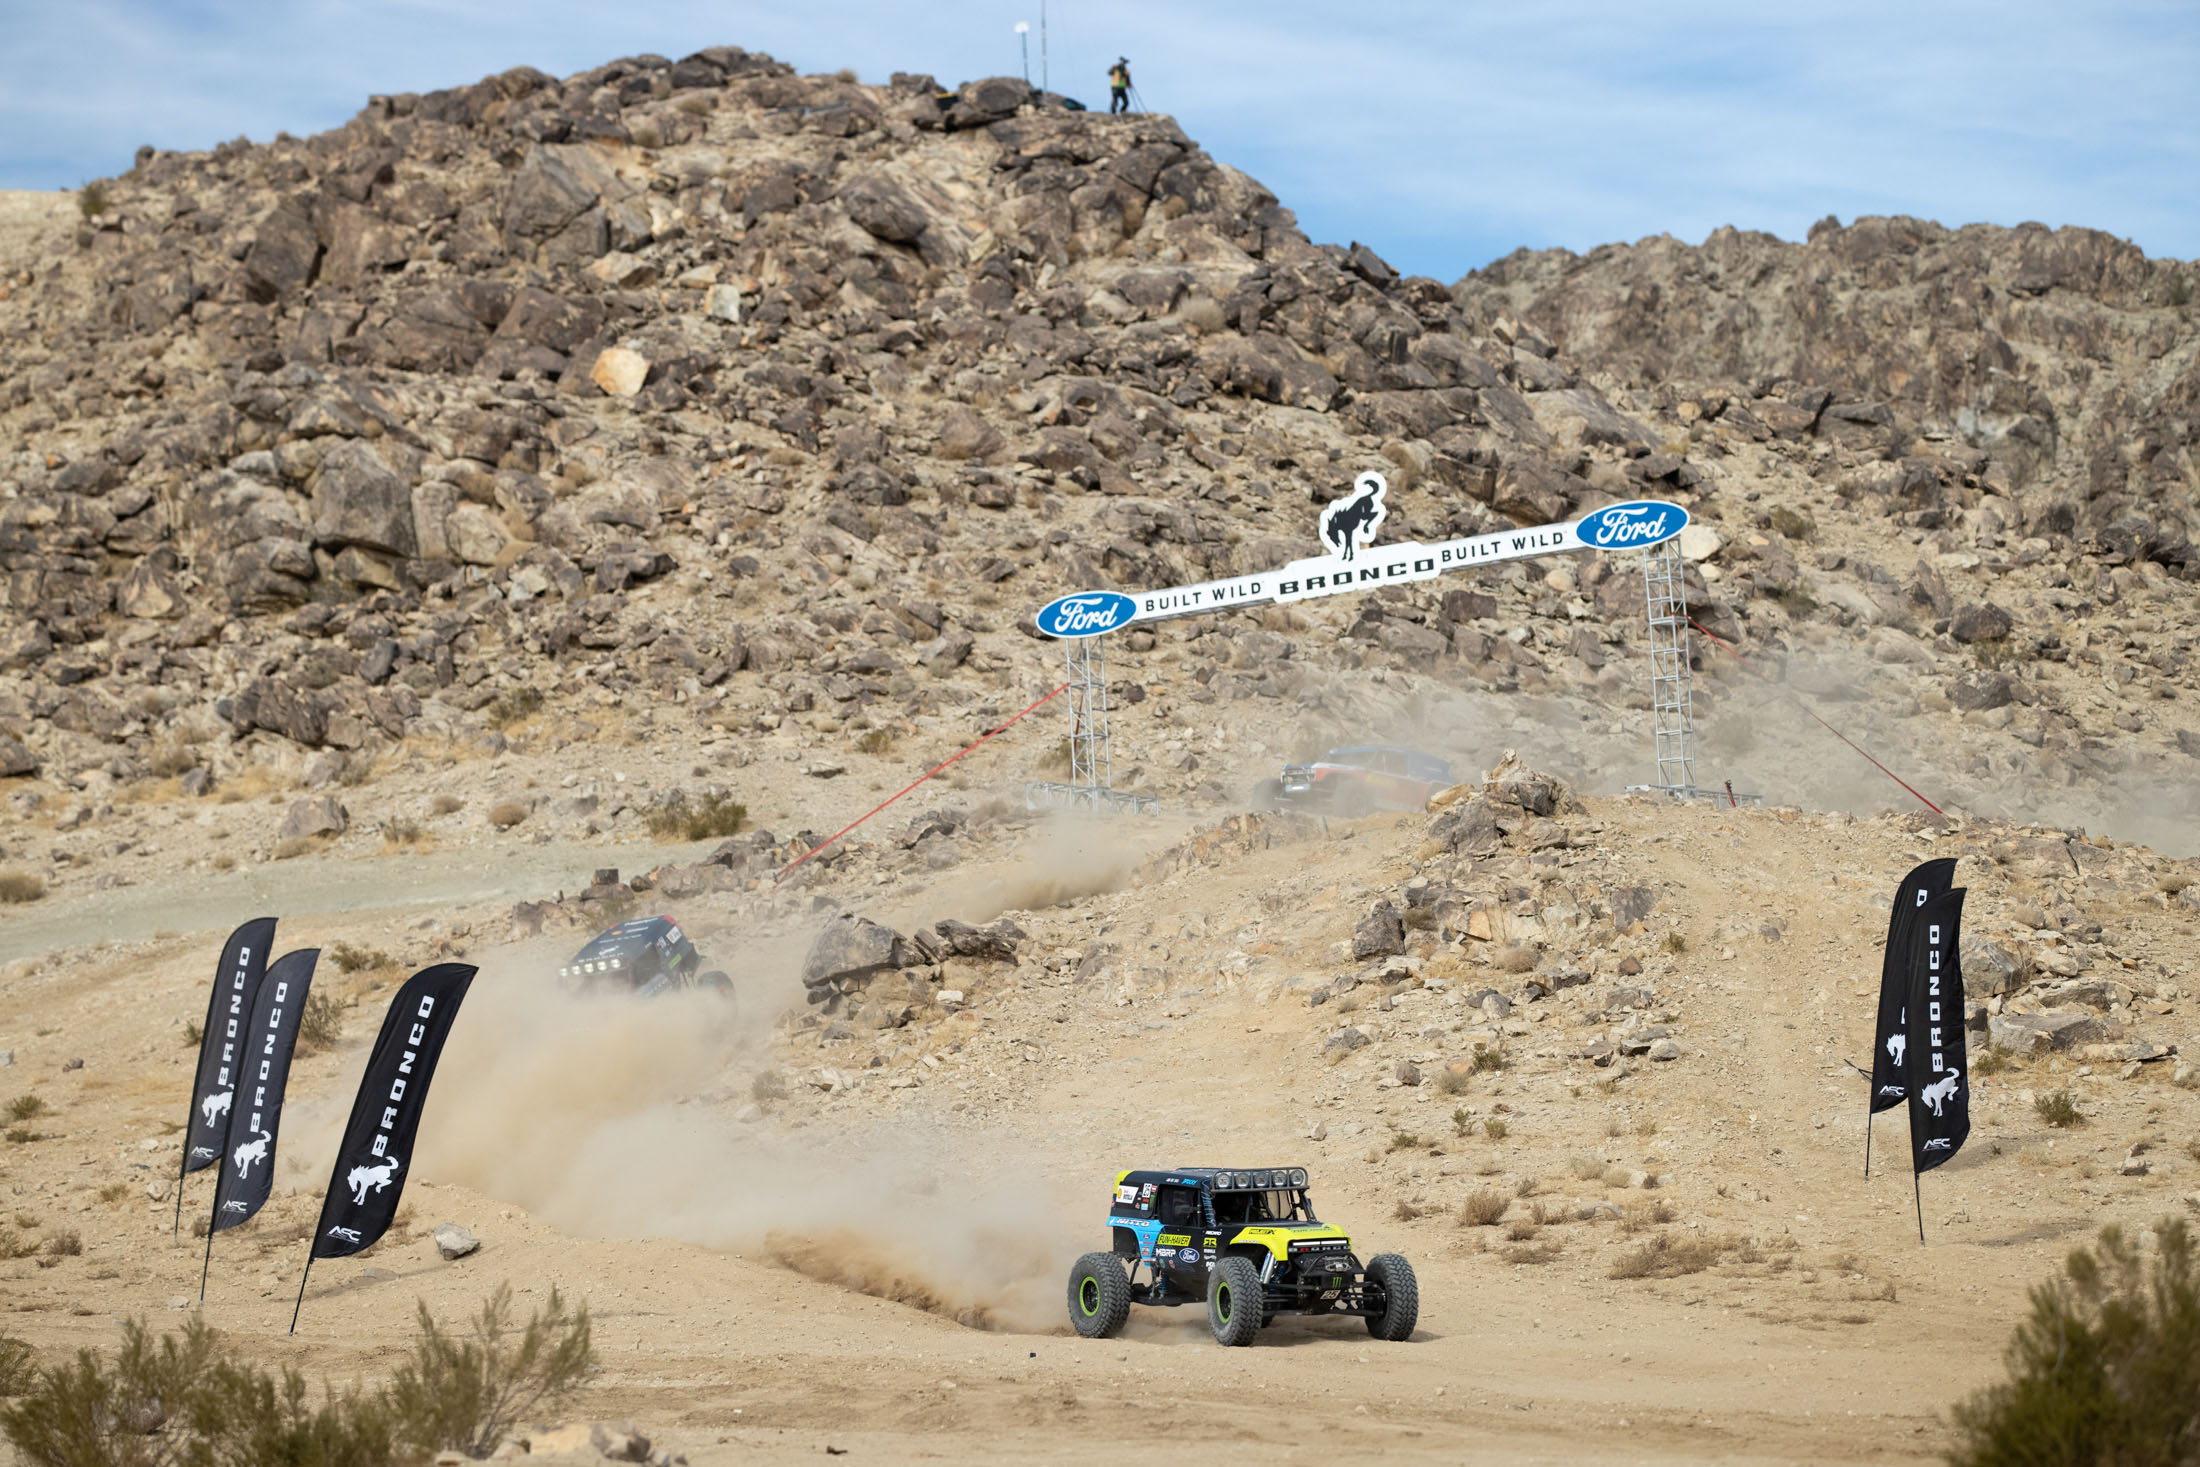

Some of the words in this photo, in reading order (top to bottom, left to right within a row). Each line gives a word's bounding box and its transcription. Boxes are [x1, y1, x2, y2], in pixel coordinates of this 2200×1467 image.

[1596, 506, 1667, 544] Ford
[1442, 541, 1501, 563] BUILT
[1512, 532, 1563, 551] WILD
[1279, 558, 1435, 595] BRONCO
[1054, 597, 1119, 632] Ford
[1145, 592, 1201, 612] BUILT
[1212, 582, 1261, 601] WILD
[217, 946, 251, 1086] BRONCO
[1929, 925, 1944, 1073] BRONCO
[249, 982, 288, 1133] BRONCO
[371, 995, 435, 1158] BRONCO
[1115, 1218, 1150, 1227] NITTO
[1155, 1248, 1176, 1257] MBRP
[1159, 1235, 1190, 1246] FUN-HAVER
[1182, 1249, 1196, 1261] Ford
